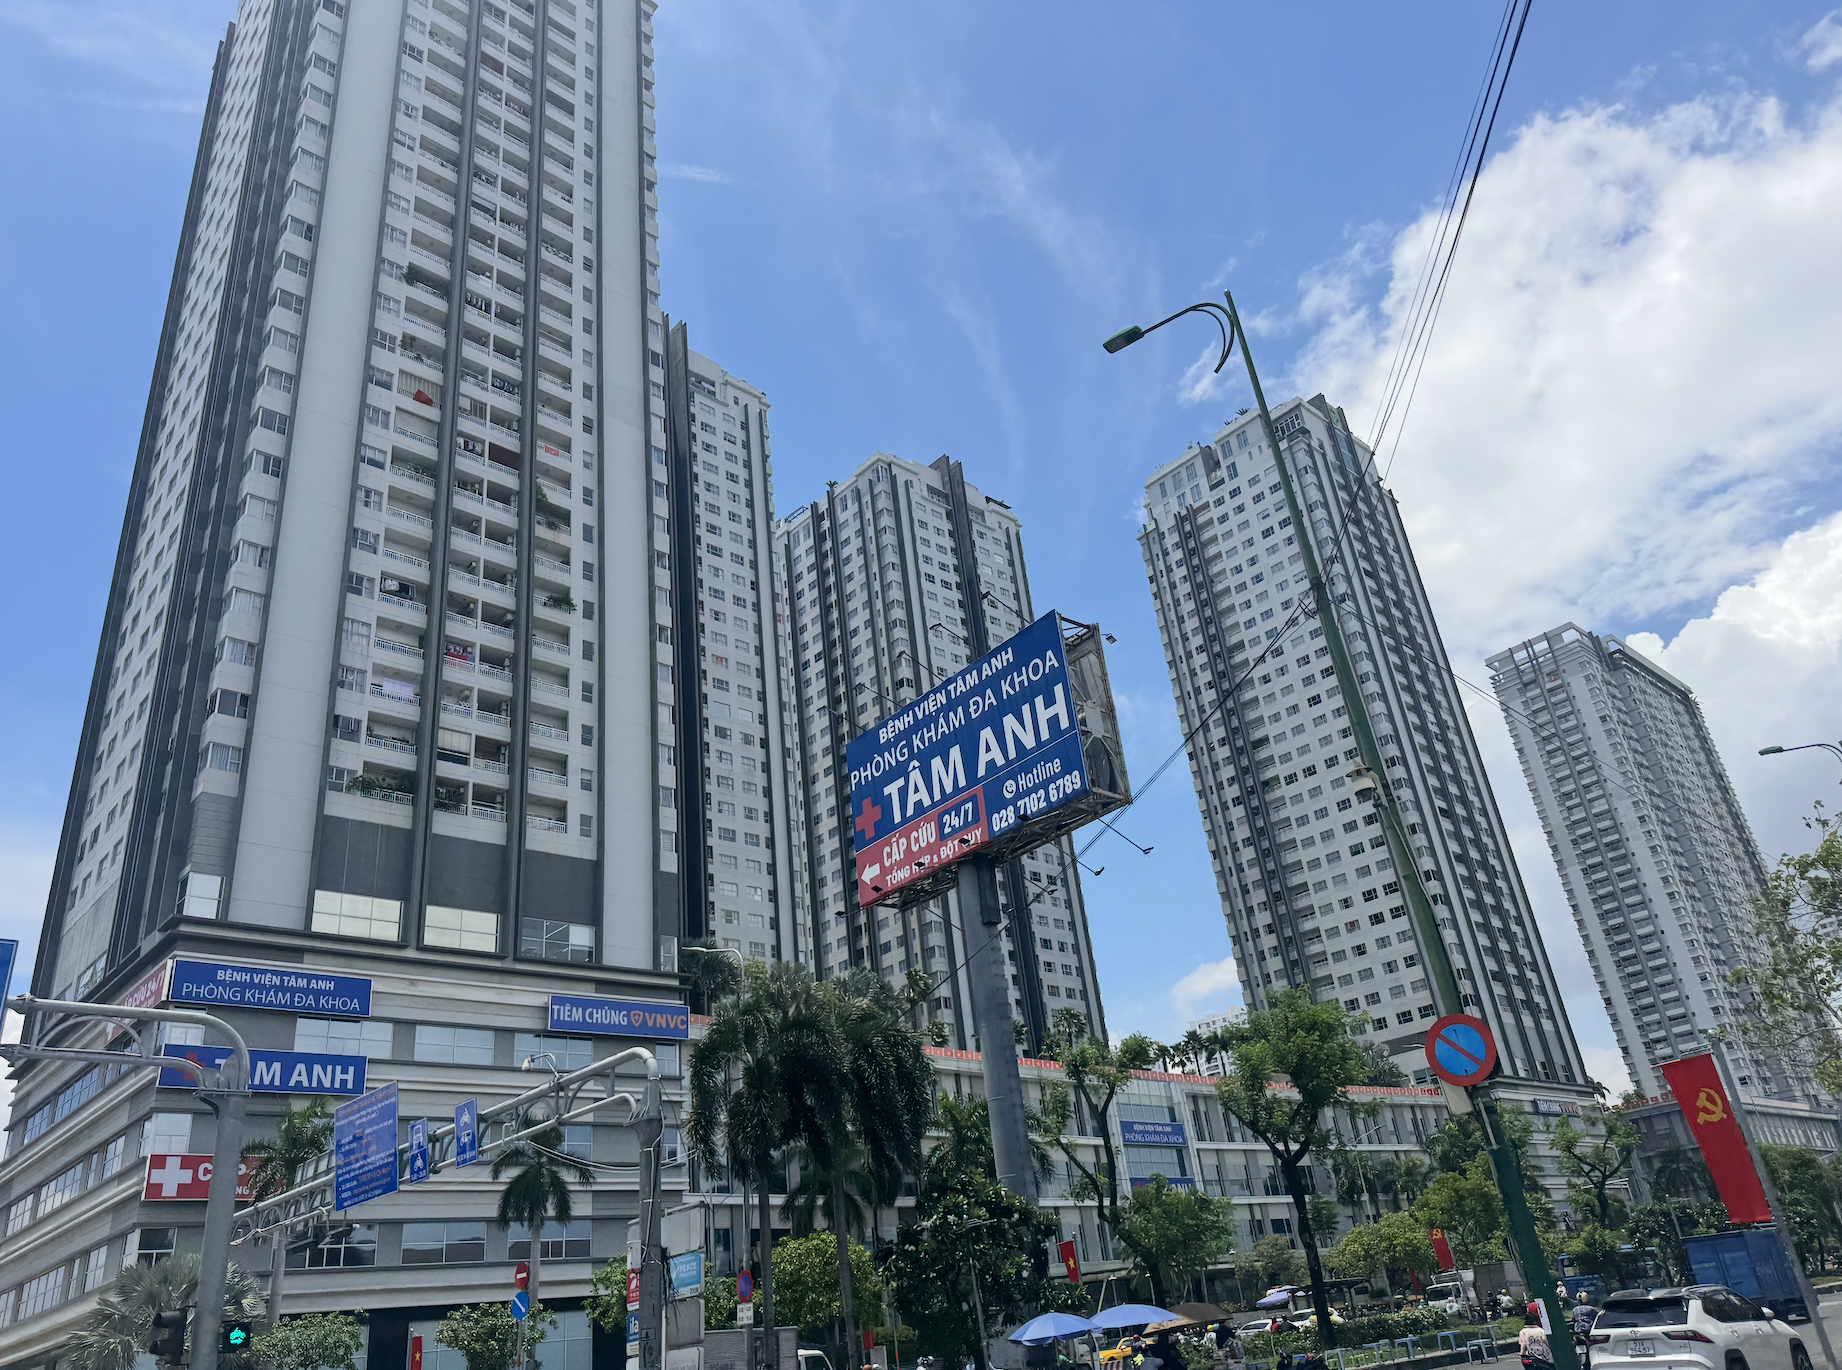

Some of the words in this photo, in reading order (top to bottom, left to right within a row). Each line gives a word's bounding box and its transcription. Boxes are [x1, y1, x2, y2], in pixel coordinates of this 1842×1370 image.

[879, 710, 914, 744] BỆNH
[914, 689, 947, 716] VIỆN
[947, 676, 979, 700] TÂM
[981, 646, 1014, 681] ANH
[850, 740, 909, 792] PHÒNG
[912, 705, 966, 754] KHÁM
[968, 688, 998, 720] ĐA
[1000, 649, 1060, 700] KHOA
[883, 743, 967, 825] TÂM
[976, 682, 1071, 779] ANH
[1017, 757, 1062, 793] Hotline
[991, 805, 1016, 832] 028
[1016, 788, 1048, 816] 7102
[1048, 769, 1082, 803] 6789
[882, 832, 908, 868] CẤP
[910, 821, 937, 853] CỨU
[942, 801, 973, 835] 24/7
[885, 865, 911, 888] TỔNG
[939, 839, 958, 860] ĐỘT
[181, 982, 241, 1001] PHÒNG
[244, 984, 291, 1006] KHÁM
[293, 992, 316, 1008] ĐA
[318, 996, 361, 1012] KHOA
[216, 969, 251, 984] BỆNH
[252, 973, 282, 988] VIỆN
[283, 976, 308, 989] TÂM
[309, 979, 335, 991] ANH
[552, 1002, 583, 1023] TIÊM
[585, 1006, 628, 1026] CHỦNG
[644, 1012, 687, 1030] VNVC
[288, 1062, 355, 1090] ANH
